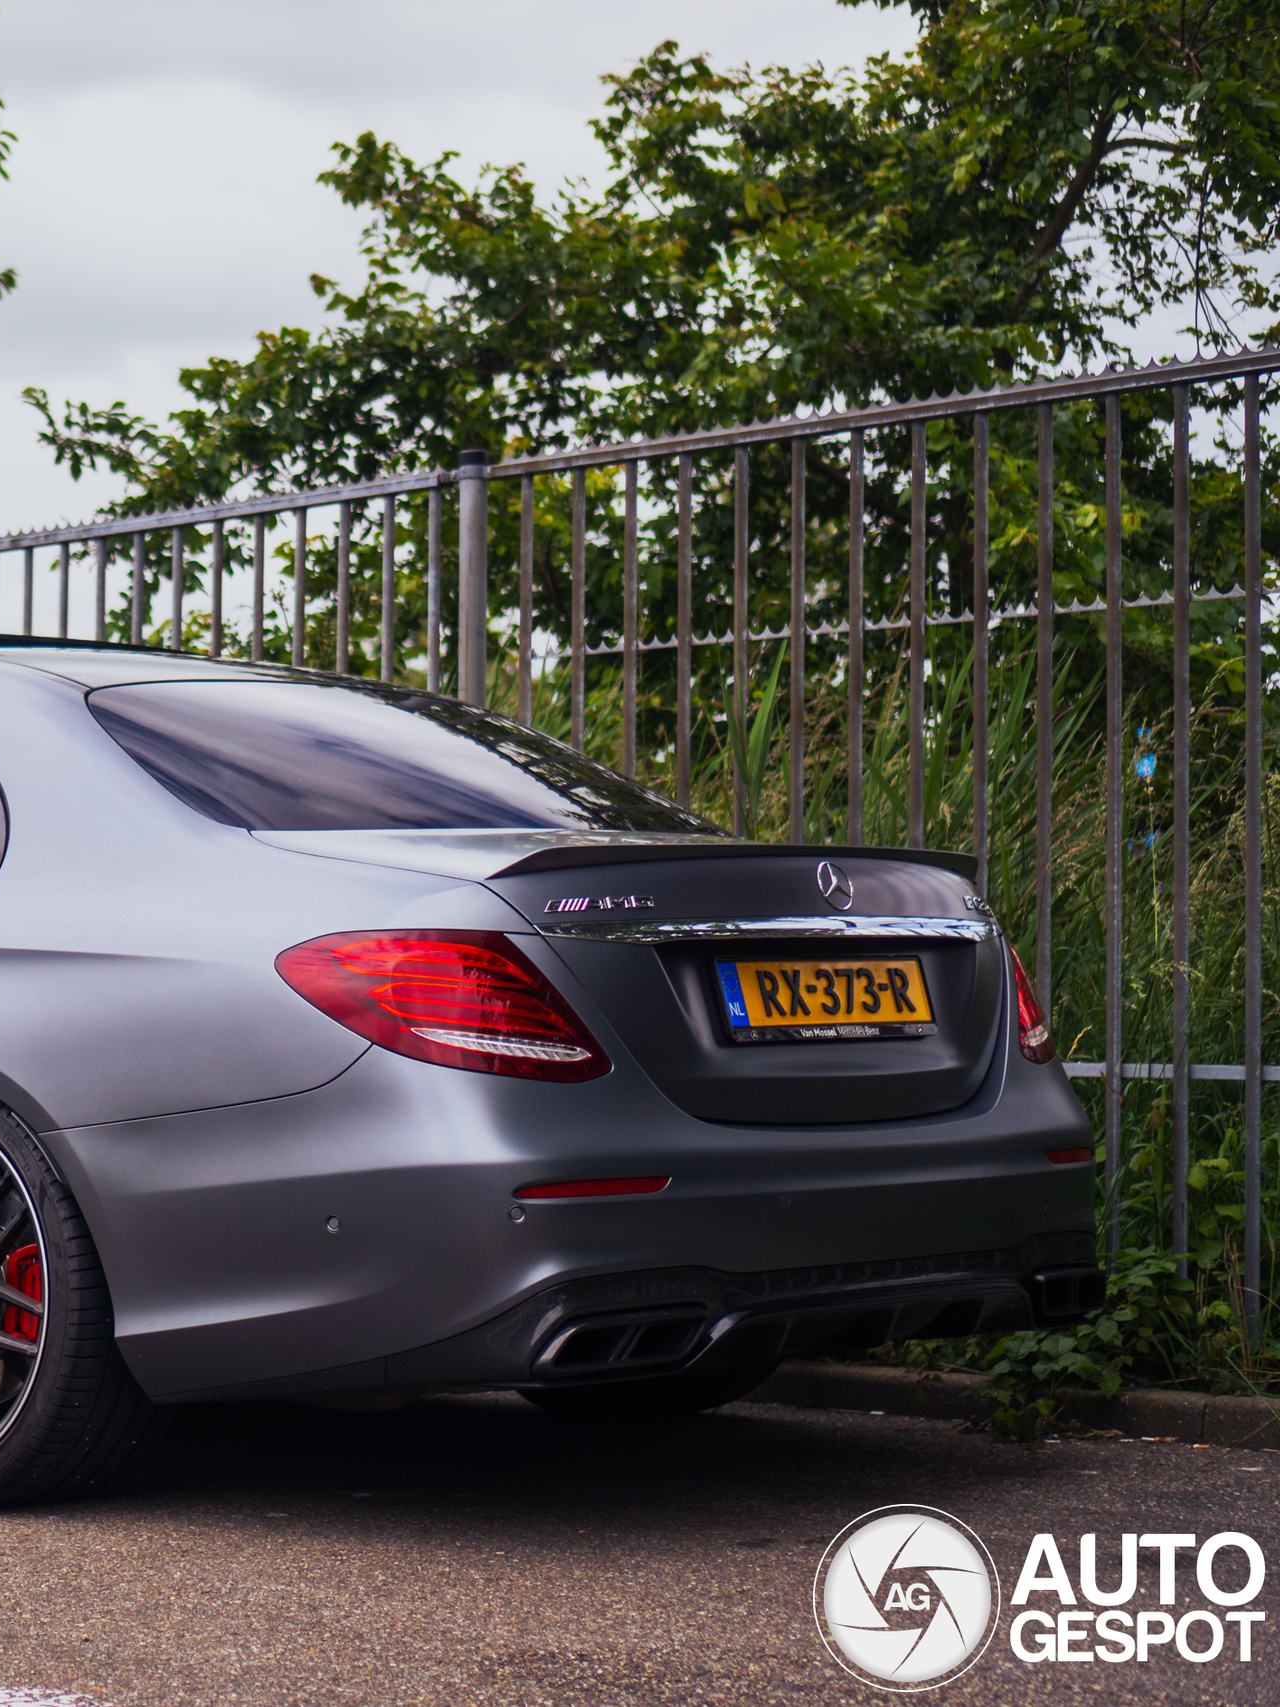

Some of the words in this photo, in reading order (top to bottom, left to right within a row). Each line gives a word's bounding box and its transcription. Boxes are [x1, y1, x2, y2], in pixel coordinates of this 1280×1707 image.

[756, 968, 917, 1017] RX-373-R
[728, 1002, 746, 1016] NL
[800, 1028, 814, 1038] Van
[814, 1026, 838, 1037] Mossel
